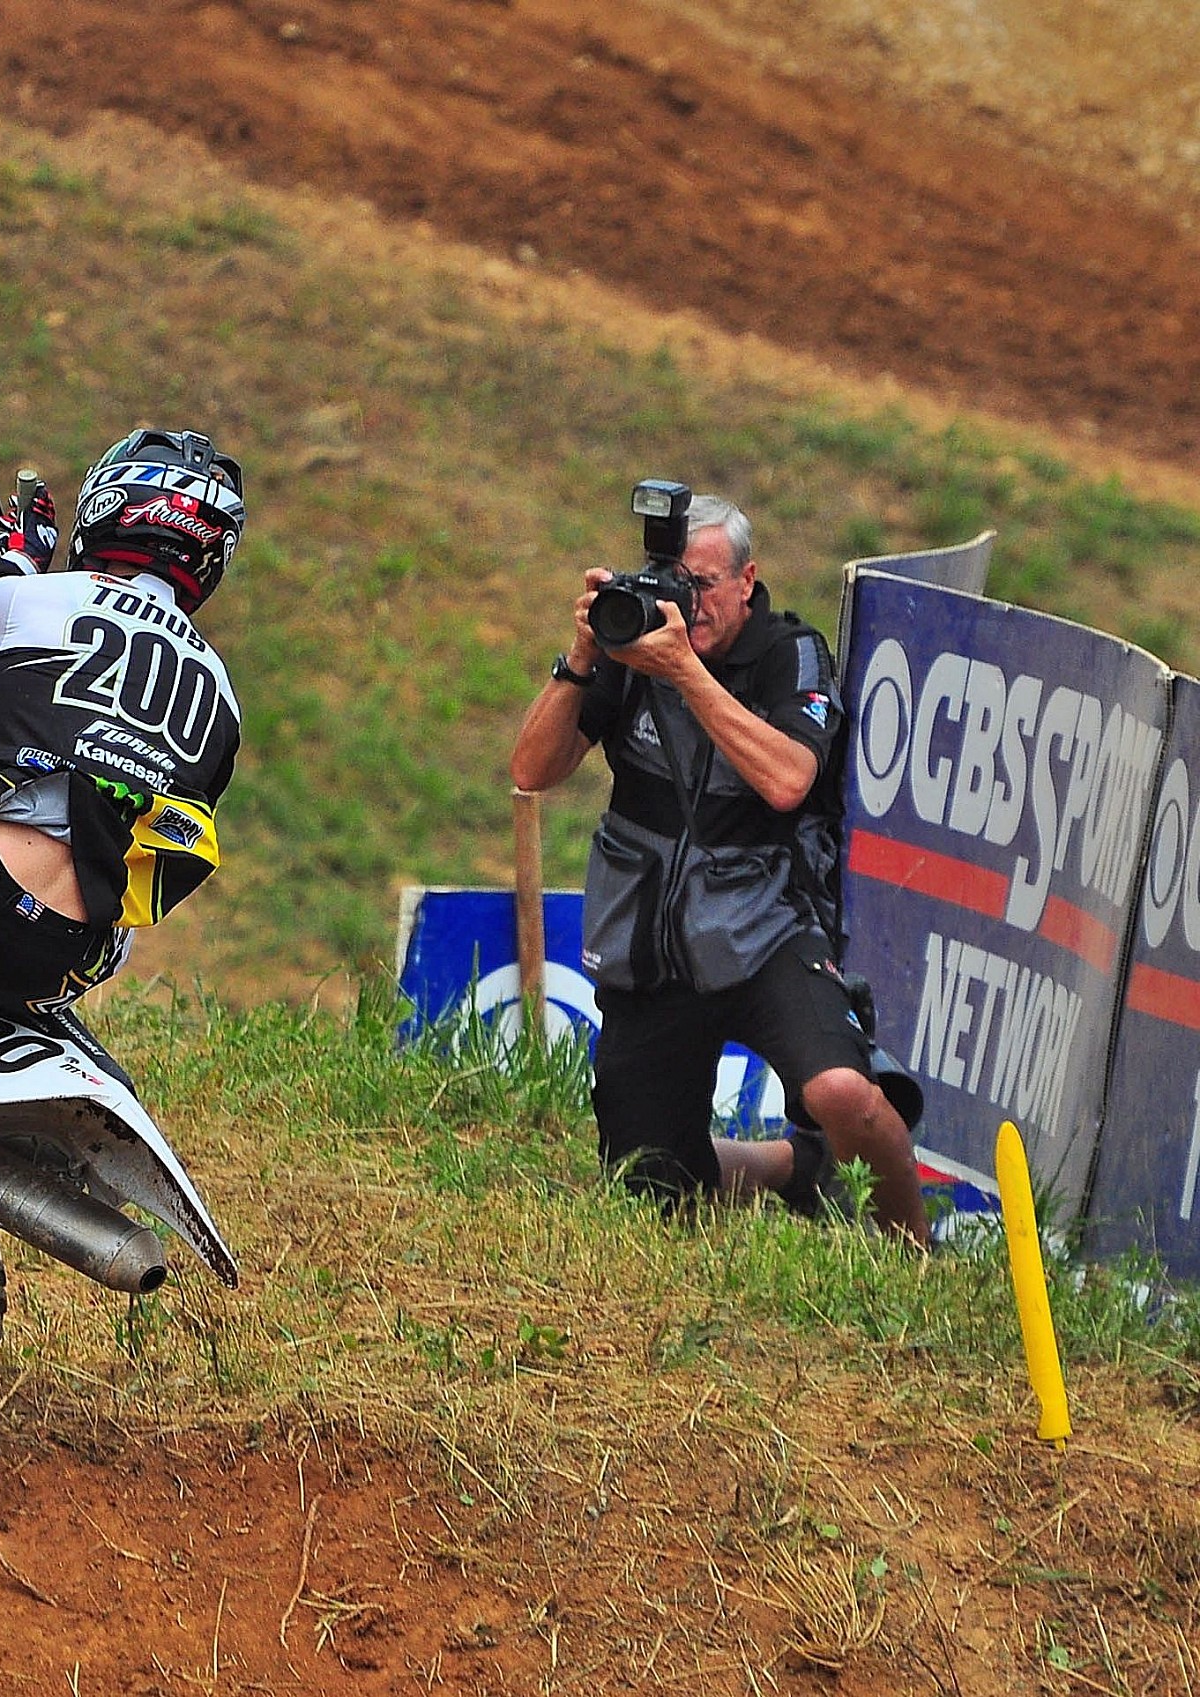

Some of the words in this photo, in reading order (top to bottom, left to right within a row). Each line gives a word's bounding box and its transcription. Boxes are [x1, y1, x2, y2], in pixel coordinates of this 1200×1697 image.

[121, 497, 221, 541] Arnaud
[57, 612, 219, 761] 200
[74, 738, 175, 794] Kawasaki
[911, 651, 1044, 846] CBS
[1006, 686, 1162, 931] SPORTS
[909, 932, 1082, 1137] NETWORK
